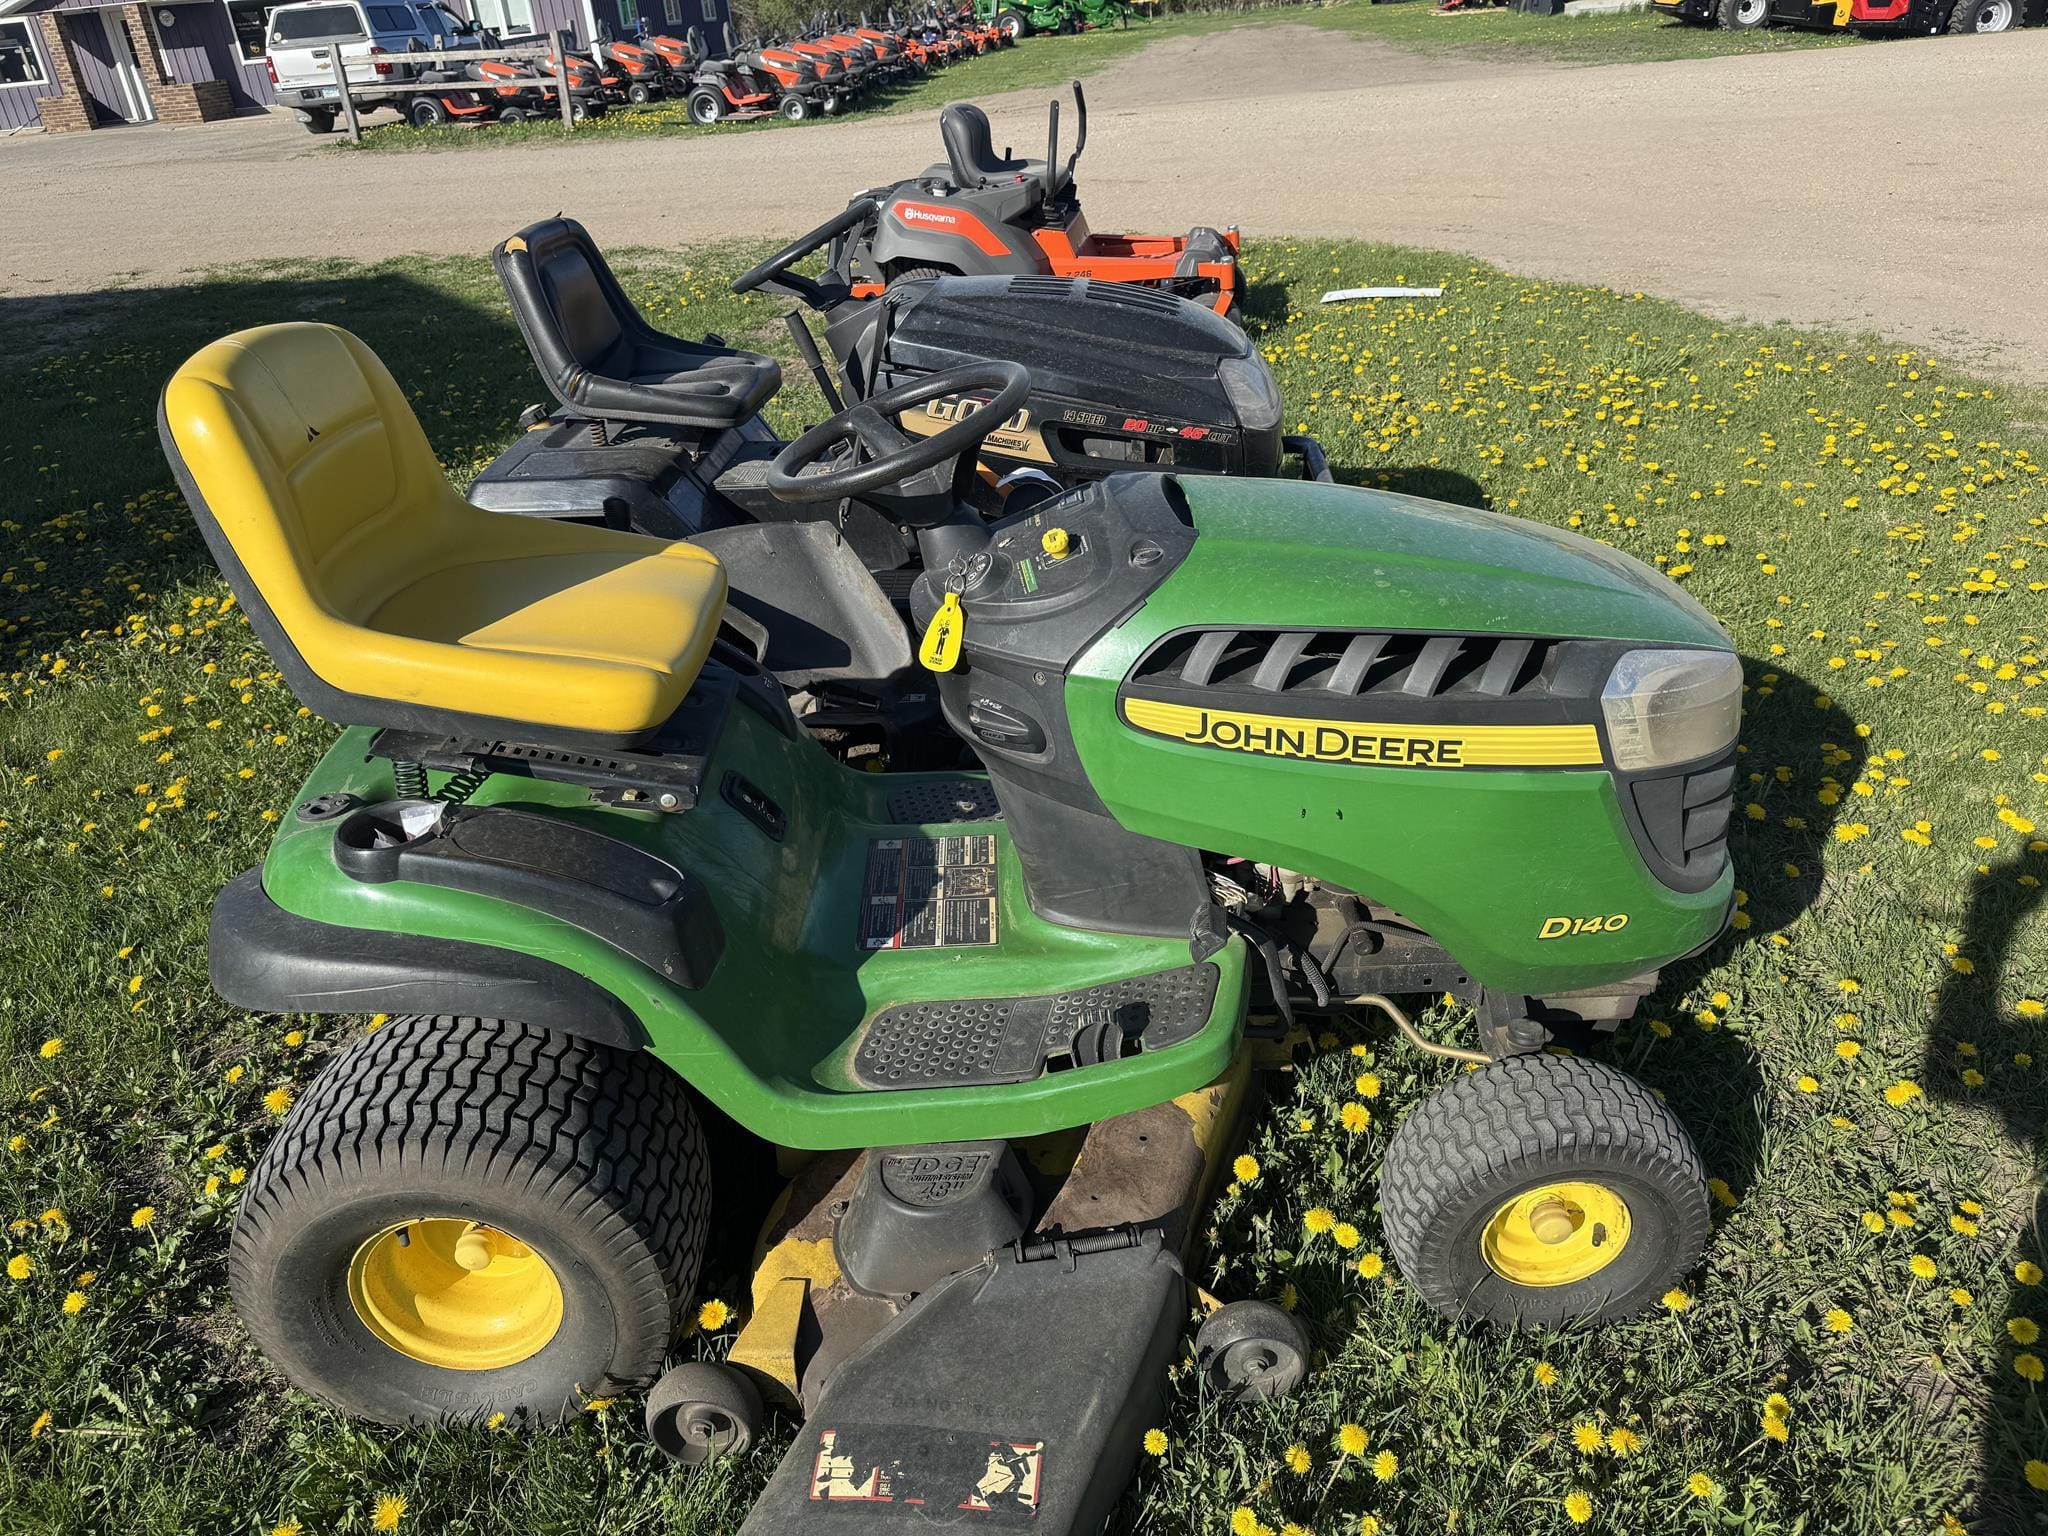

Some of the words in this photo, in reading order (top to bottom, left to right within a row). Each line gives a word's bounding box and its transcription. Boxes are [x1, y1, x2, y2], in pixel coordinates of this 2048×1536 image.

[913, 210, 956, 224] Husqvarna
[1074, 270, 1092, 278] 246
[926, 399, 1031, 433] GOD
[1063, 409, 1076, 421] 14
[1076, 411, 1107, 425] SPEED
[1185, 712, 1305, 754] JOHN
[1316, 727, 1463, 764] DEERE
[1537, 913, 1629, 939] D140
[898, 1156, 981, 1175] EDGE
[421, 1378, 538, 1404] CARLISLE
